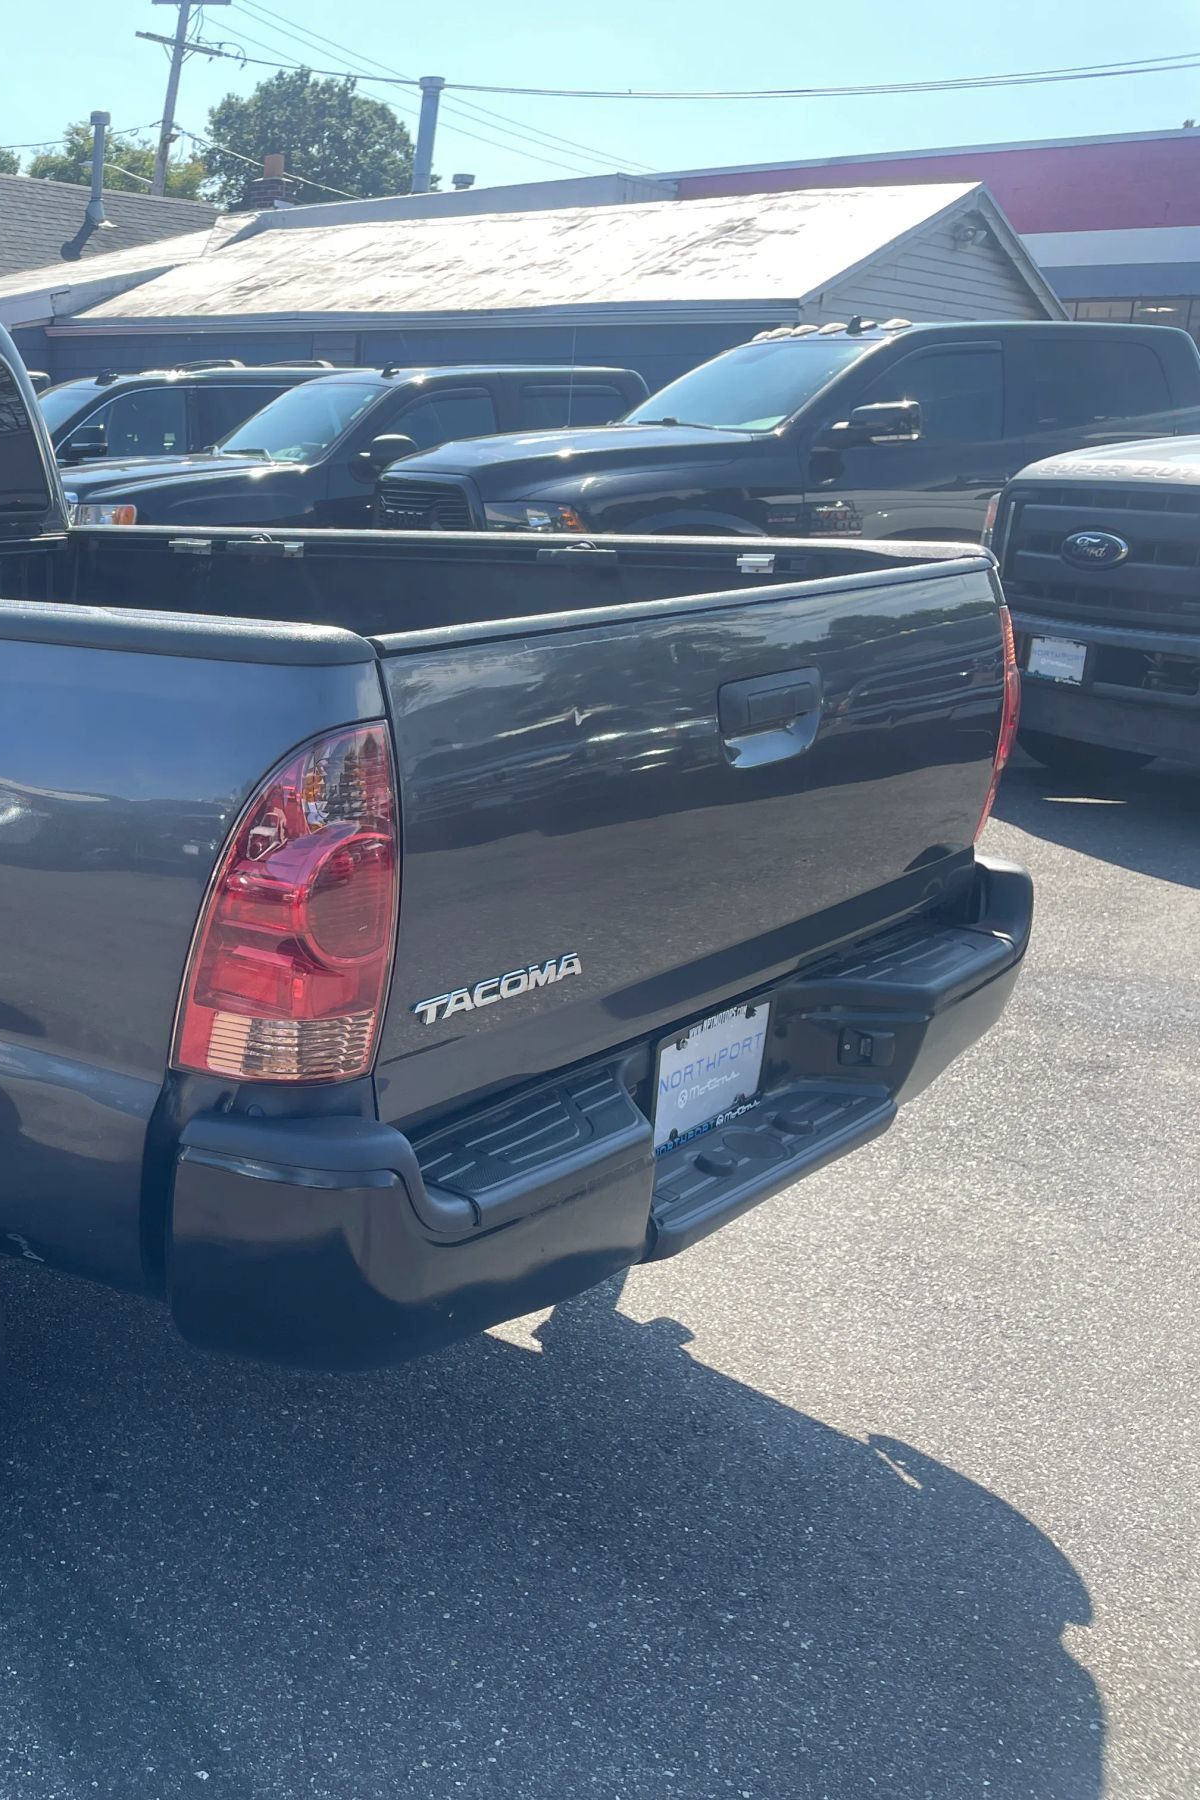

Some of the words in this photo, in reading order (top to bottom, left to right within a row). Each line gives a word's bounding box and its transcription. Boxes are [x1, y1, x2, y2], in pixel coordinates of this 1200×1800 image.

[1039, 463, 1126, 478] SUPER
[1072, 536, 1110, 558] Ford
[414, 952, 583, 1026] TACOMA
[659, 1031, 764, 1097] NORTHPORT
